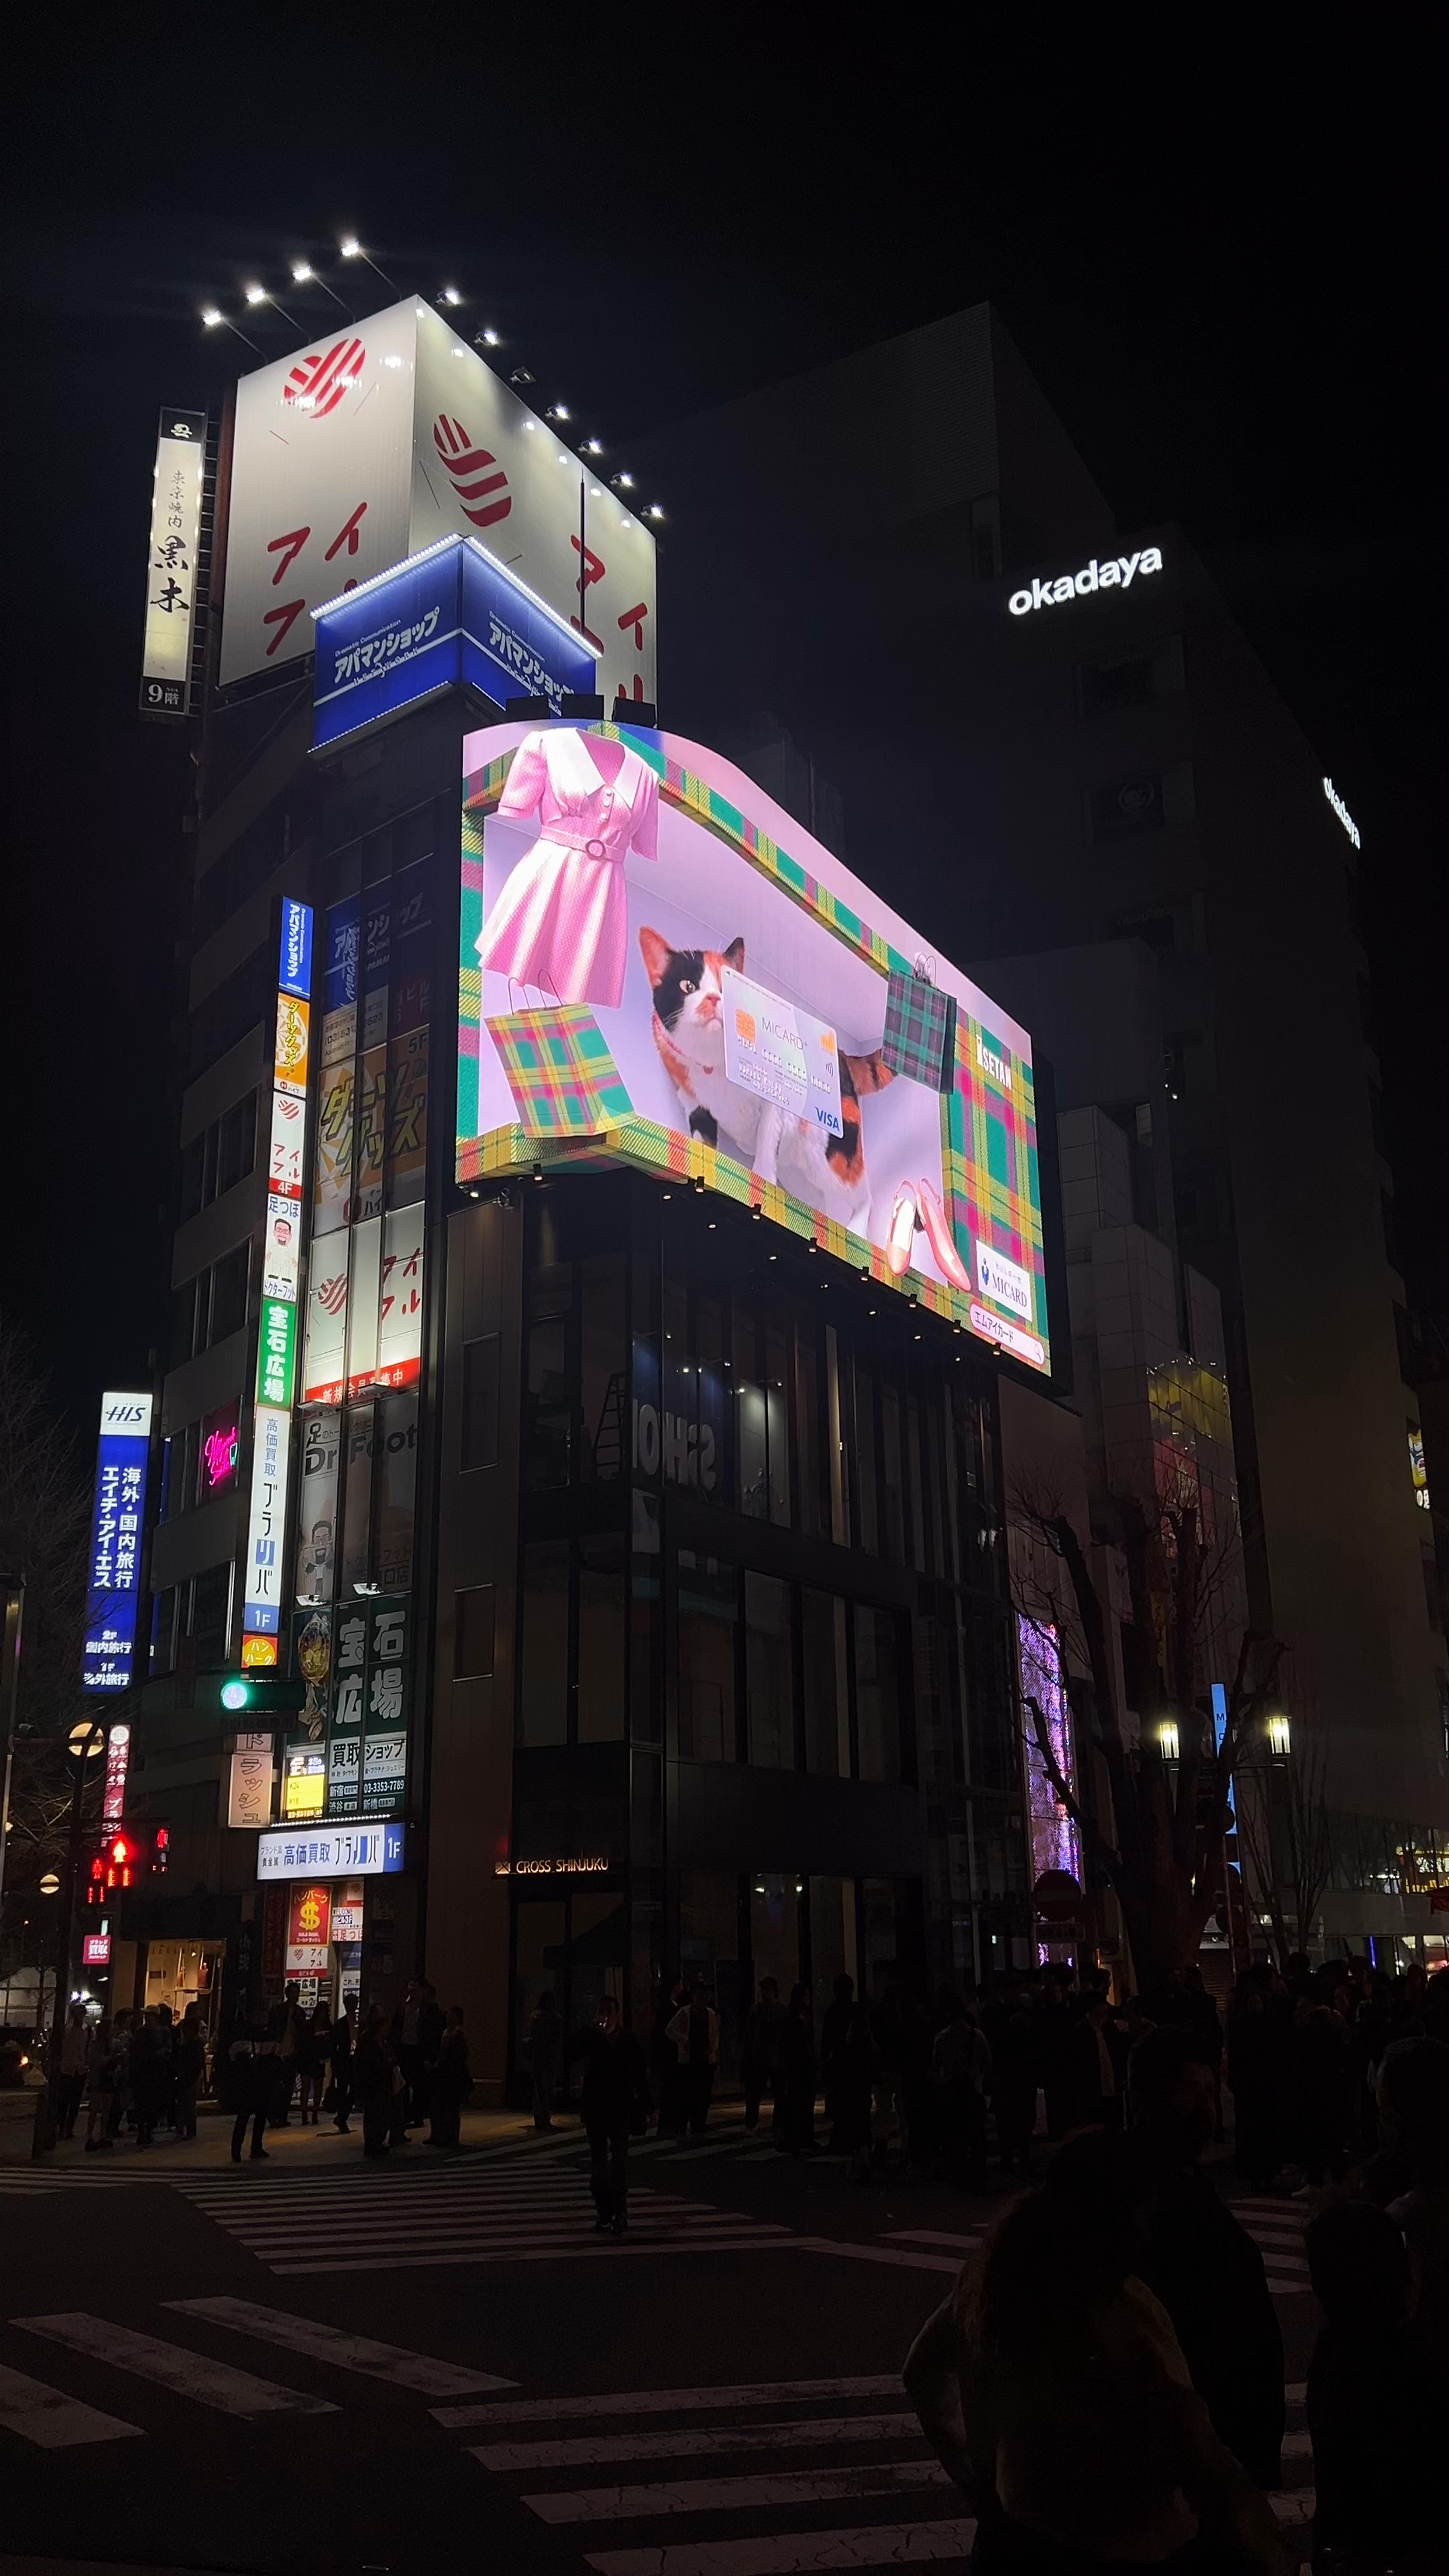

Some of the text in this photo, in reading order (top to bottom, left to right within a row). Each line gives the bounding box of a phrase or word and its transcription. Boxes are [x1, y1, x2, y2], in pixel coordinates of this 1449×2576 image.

[268, 502, 367, 585] アイ
[150, 535, 189, 613] 黒木
[1009, 547, 1163, 616] okadaya
[570, 535, 648, 651] アイ
[335, 606, 440, 684] アパマンショップ
[148, 684, 179, 705] 9階
[287, 903, 300, 977] アパマンショップ
[815, 1106, 840, 1132] VISA
[274, 1143, 300, 1162] アイ
[273, 1162, 300, 1179] フル
[278, 1181, 293, 1195] 4F
[382, 1289, 421, 1320] フル
[992, 1273, 1027, 1307] MICARD
[975, 1311, 1014, 1343] エムアイカード
[263, 1306, 288, 1403] 宝石広場
[322, 1369, 403, 1403] 新規会員集中
[106, 1406, 146, 1422] HIS
[263, 1418, 278, 1477] 高価買取
[305, 1424, 417, 1476] Dr Foot
[93, 1467, 119, 1588] エイチ・アイ・エス
[115, 1467, 142, 1588] 海外・国内旅行
[255, 1483, 278, 1595] ブラリバ
[102, 1630, 118, 1640] 2F
[255, 1610, 271, 1627] 1F
[85, 1641, 132, 1654] 国内旅行
[338, 1610, 406, 1668] 宝石
[100, 1662, 115, 1672] 1F
[335, 1667, 404, 1724] 広場
[364, 1780, 405, 1793] 03-3353-7789
[284, 1835, 380, 1866] 高価買取 ブラリバ
[388, 1837, 401, 1858] 1F
[516, 1857, 609, 1874] CROSS SHINJUKU
